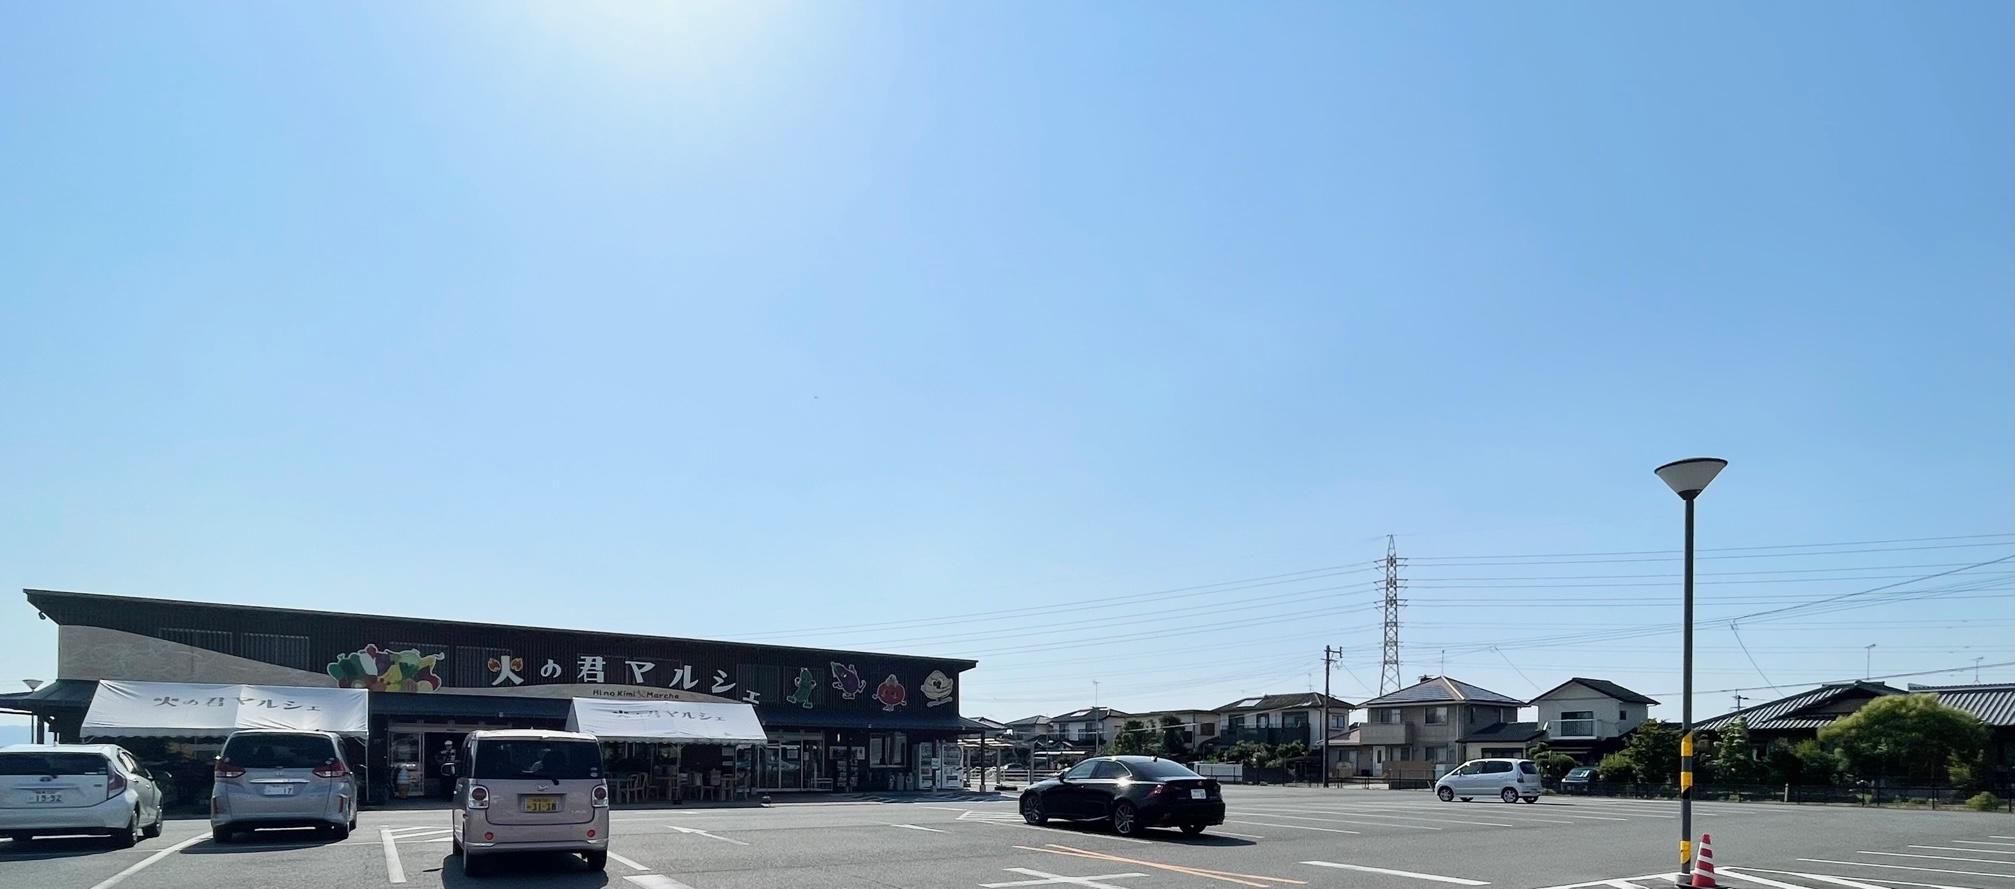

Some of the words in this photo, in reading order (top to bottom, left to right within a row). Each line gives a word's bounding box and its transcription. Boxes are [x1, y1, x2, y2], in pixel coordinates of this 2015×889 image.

[489, 655, 760, 705] 火の君マルシェ
